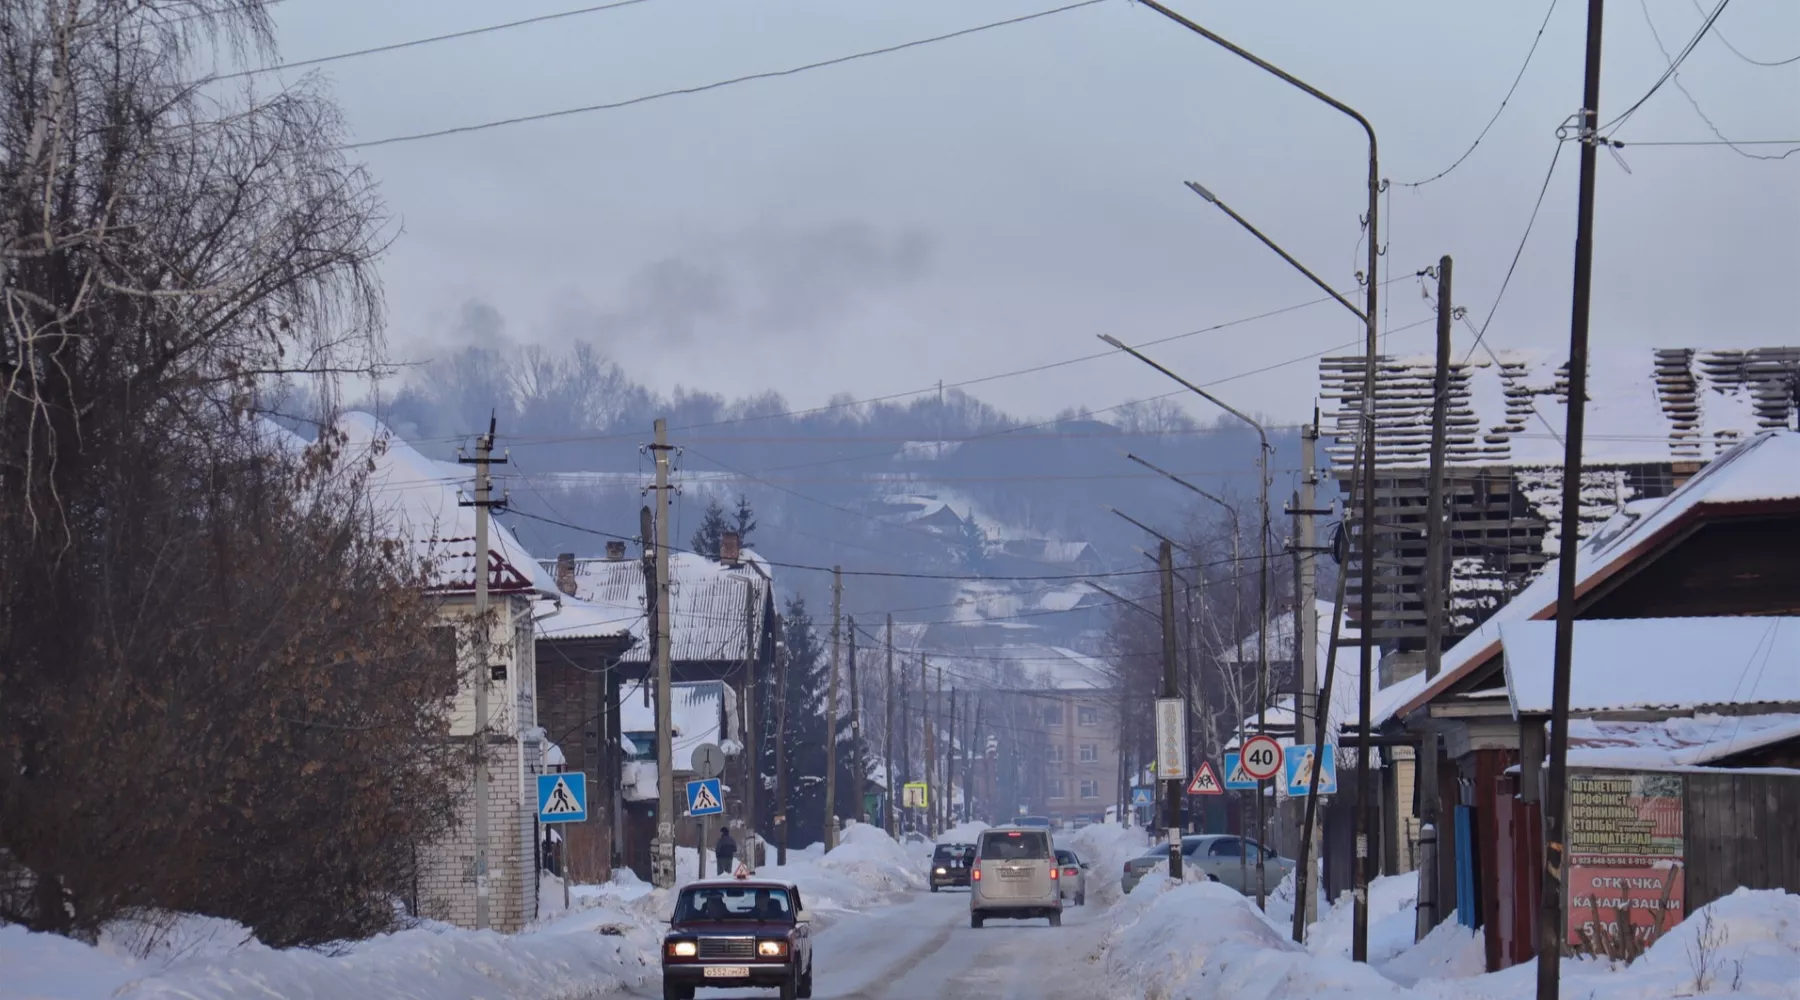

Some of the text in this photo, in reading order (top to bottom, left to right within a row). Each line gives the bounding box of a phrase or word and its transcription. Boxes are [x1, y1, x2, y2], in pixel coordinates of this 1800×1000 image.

[1249, 749, 1273, 765] 40
[1572, 780, 1632, 792] ШТАКЕТНИК
[1572, 792, 1628, 805] ПРОФЛИСТ
[1572, 806, 1638, 818] ПРОЖИЛИНЫ
[1572, 832, 1651, 845] ПИЛОМАТЕРИАЛ
[1572, 896, 1681, 911] КАНАЛЗАЦИ
